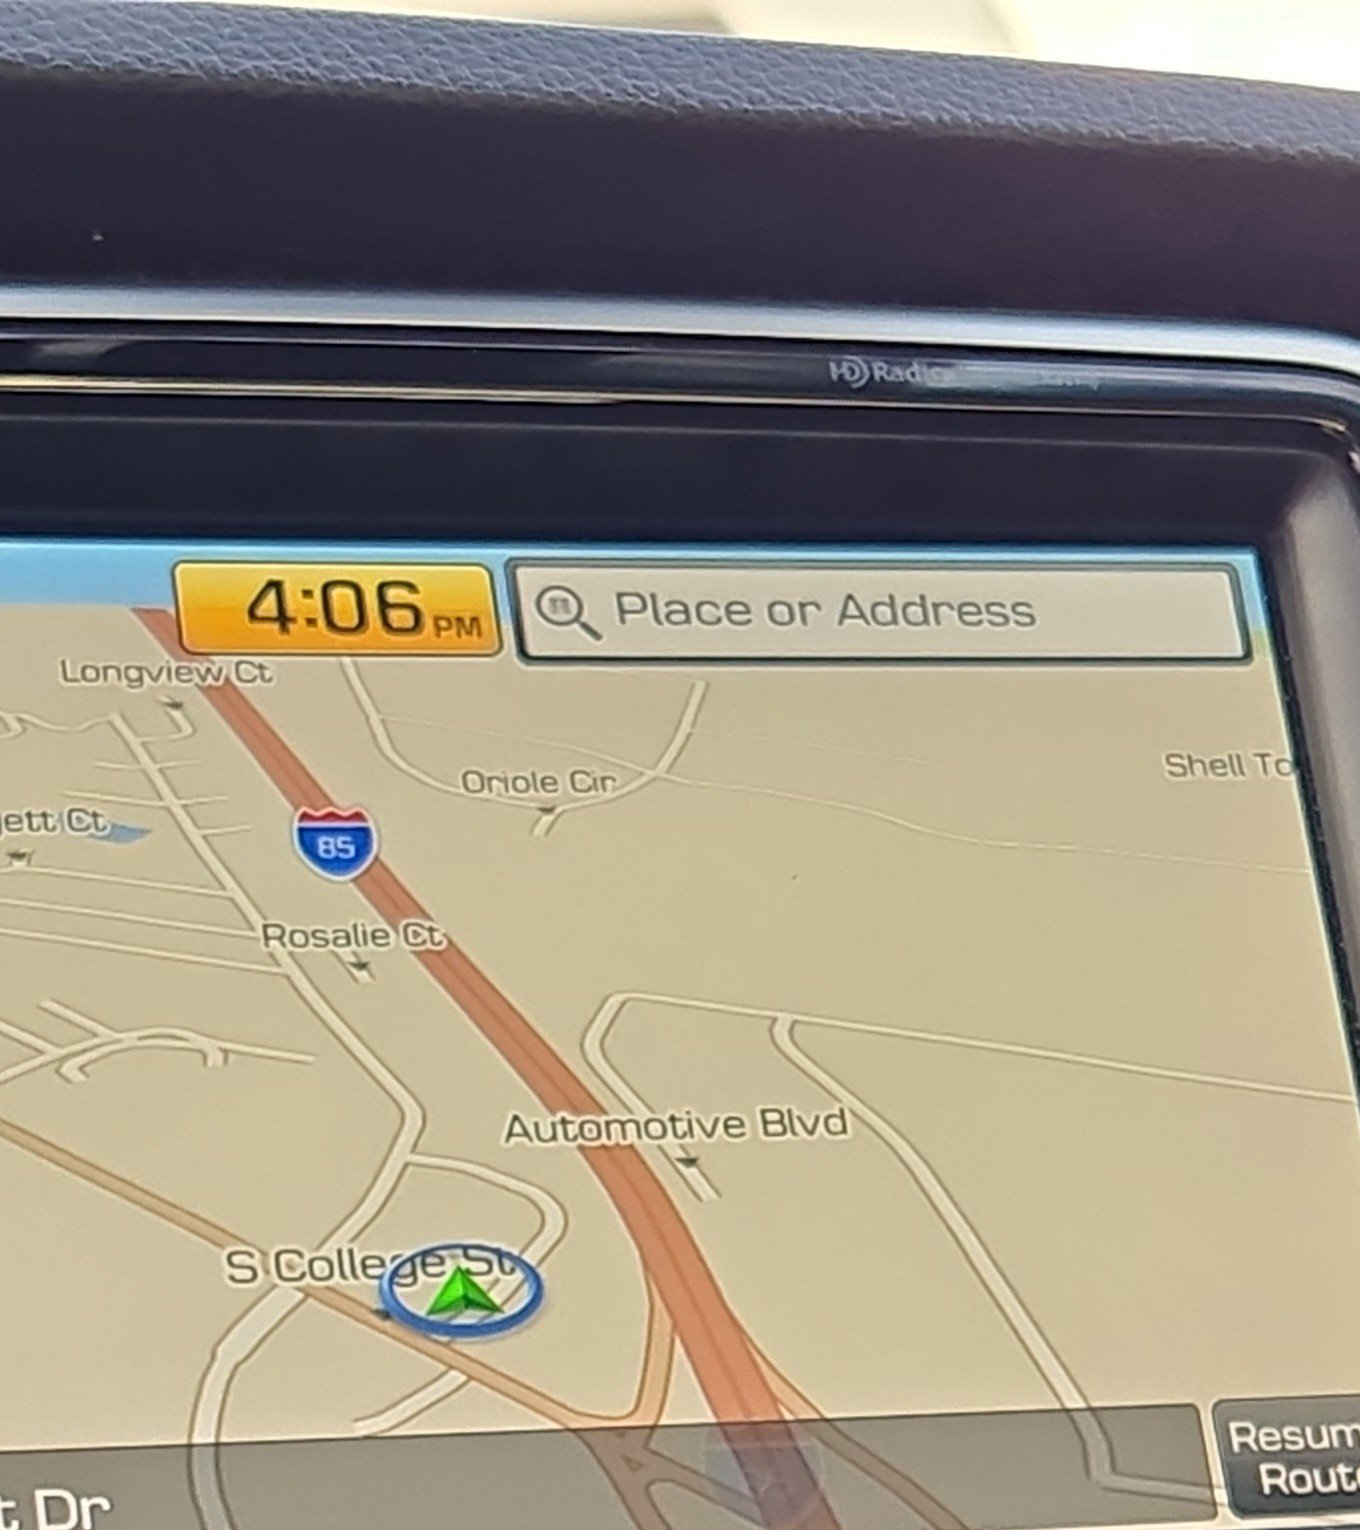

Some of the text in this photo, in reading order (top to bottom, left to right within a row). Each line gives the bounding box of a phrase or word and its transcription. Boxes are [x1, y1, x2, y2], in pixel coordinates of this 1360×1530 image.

[246, 578, 483, 639] 4:06 PM
[614, 591, 1037, 629] Place or Address
[60, 660, 273, 690] Longview Ct
[1165, 752, 1247, 779] Shell
[461, 768, 559, 794] Oriole
[65, 808, 109, 834] Ct
[316, 835, 356, 862] 85
[261, 923, 445, 949] Rosalie Ct
[504, 1106, 849, 1146] Automotive Blvd
[226, 1249, 258, 1284] S
[274, 1246, 447, 1287] College
